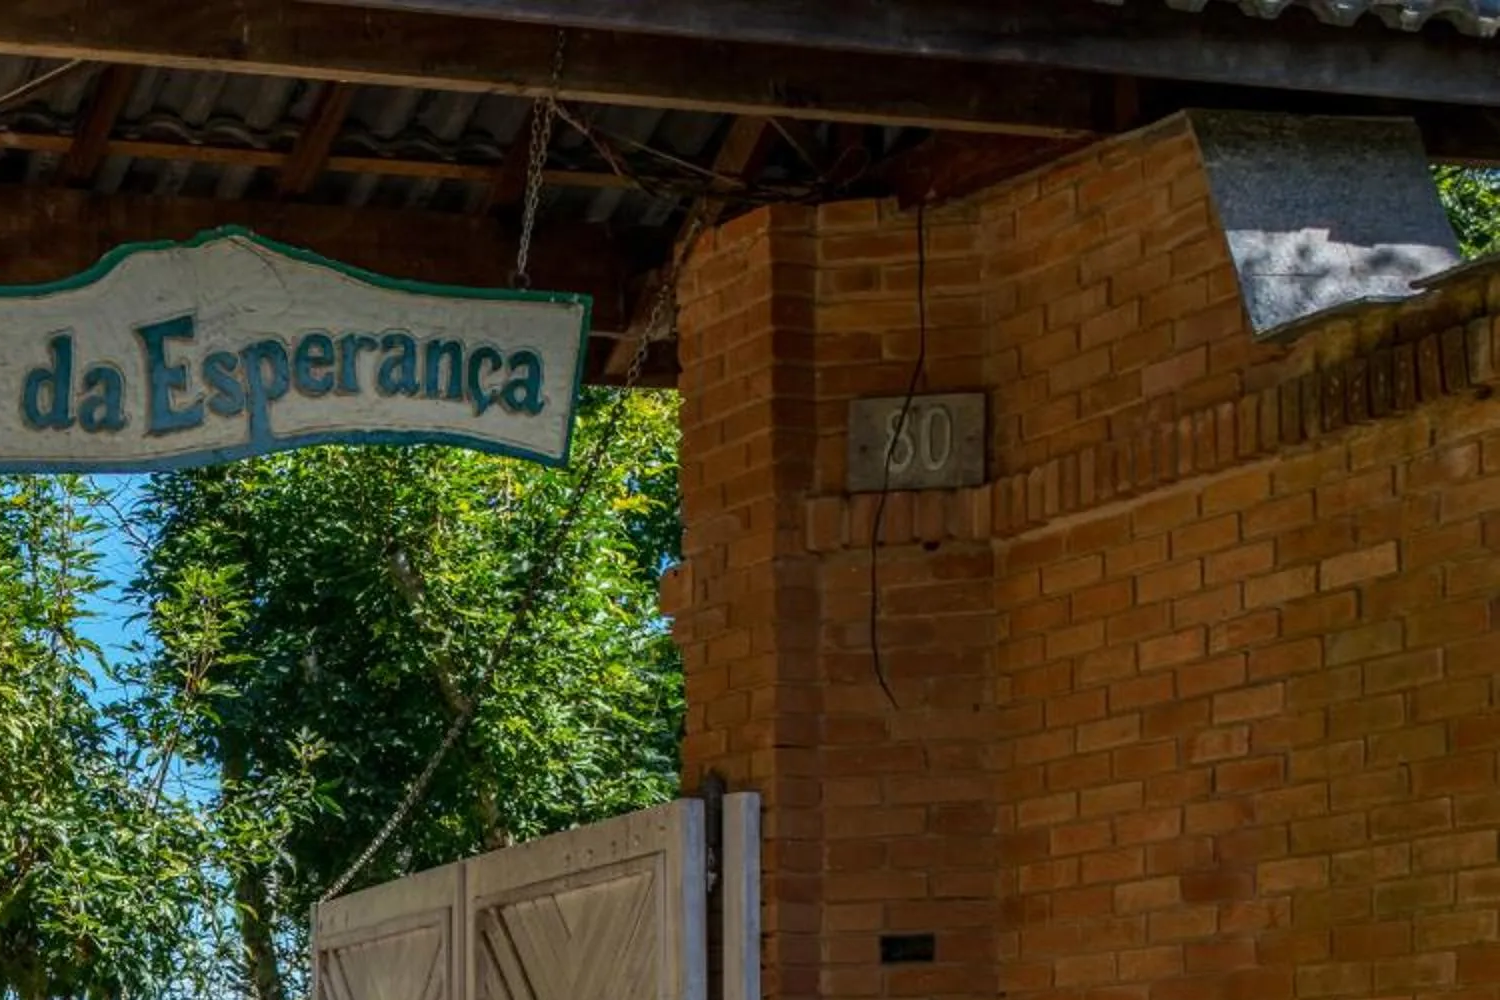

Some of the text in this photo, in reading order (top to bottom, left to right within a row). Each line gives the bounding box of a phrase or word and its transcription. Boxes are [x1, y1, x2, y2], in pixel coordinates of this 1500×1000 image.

[21, 332, 127, 434] da
[136, 314, 546, 450] Esperança
[883, 407, 953, 474] 80
